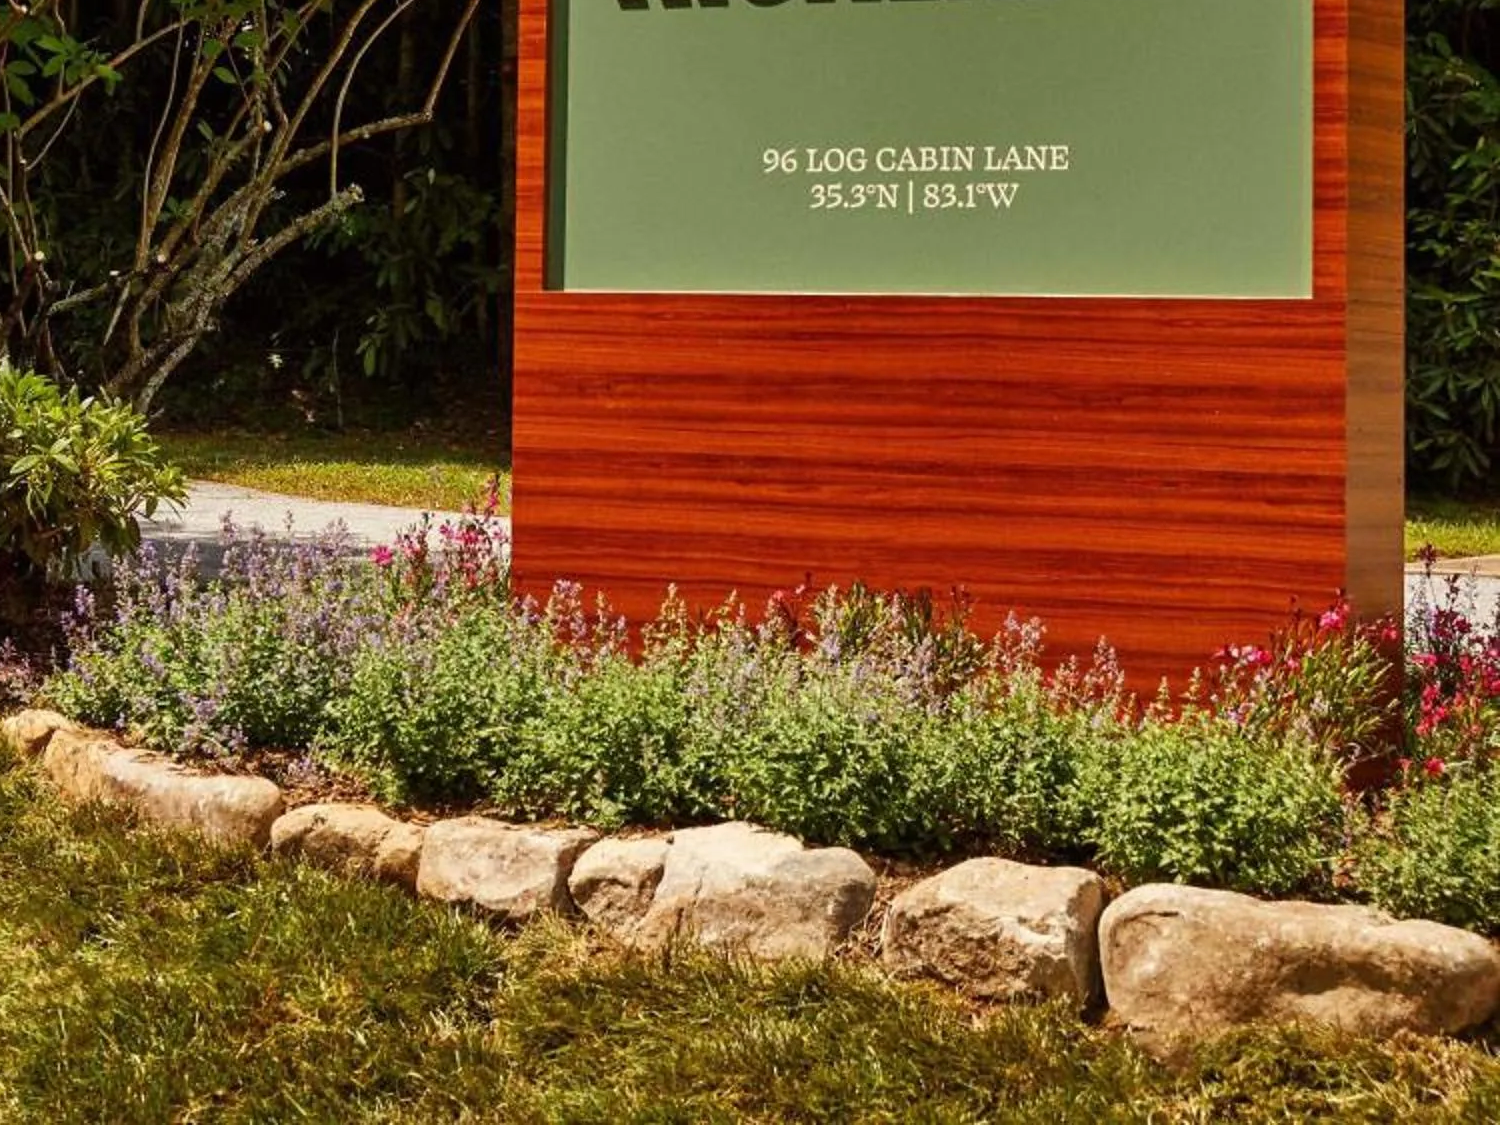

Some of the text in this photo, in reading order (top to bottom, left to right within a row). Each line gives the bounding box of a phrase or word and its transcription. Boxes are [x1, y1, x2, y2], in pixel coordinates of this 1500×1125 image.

[762, 144, 1069, 173] 96 LOG CABIN LANE
